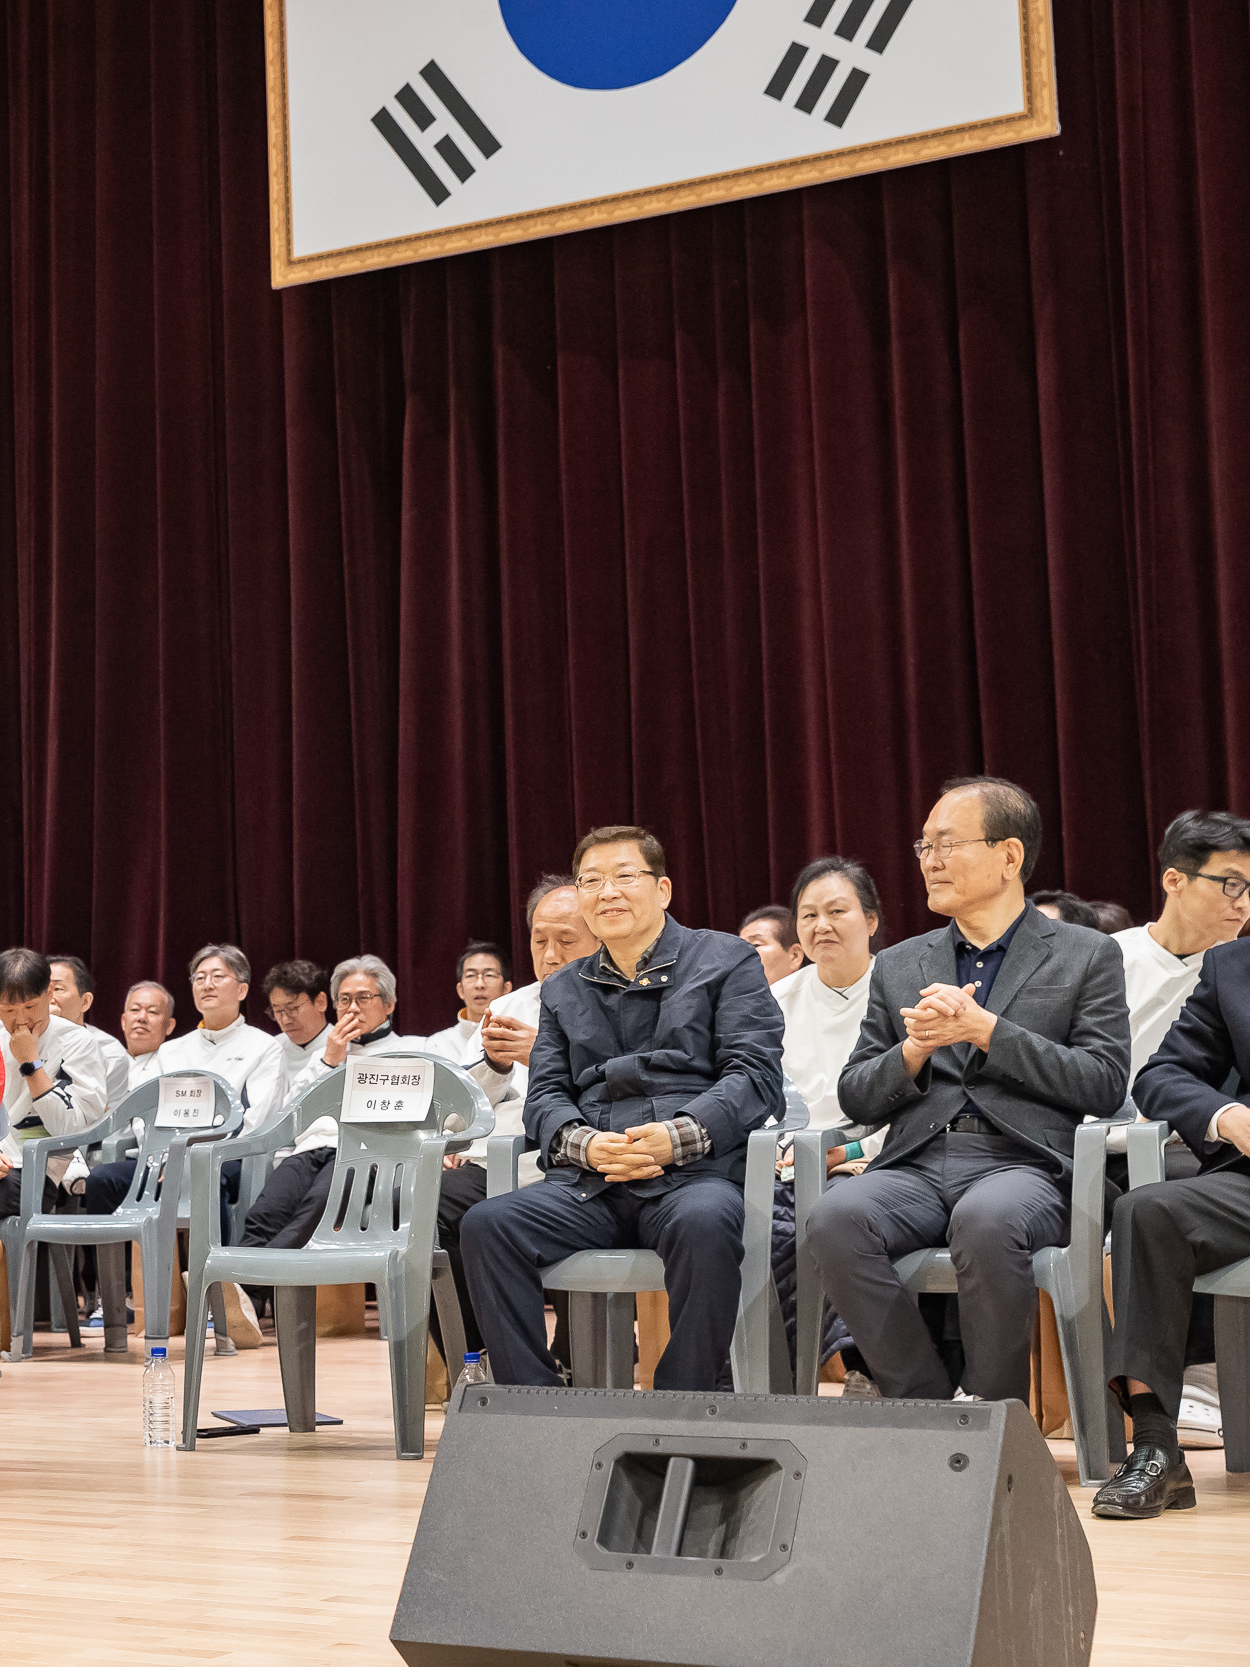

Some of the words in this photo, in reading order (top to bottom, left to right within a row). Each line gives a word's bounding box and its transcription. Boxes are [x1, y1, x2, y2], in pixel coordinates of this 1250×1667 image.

[357, 1073, 421, 1085] 광진구협회장
[175, 1090, 187, 1098] SM
[189, 1089, 202, 1098] 회장
